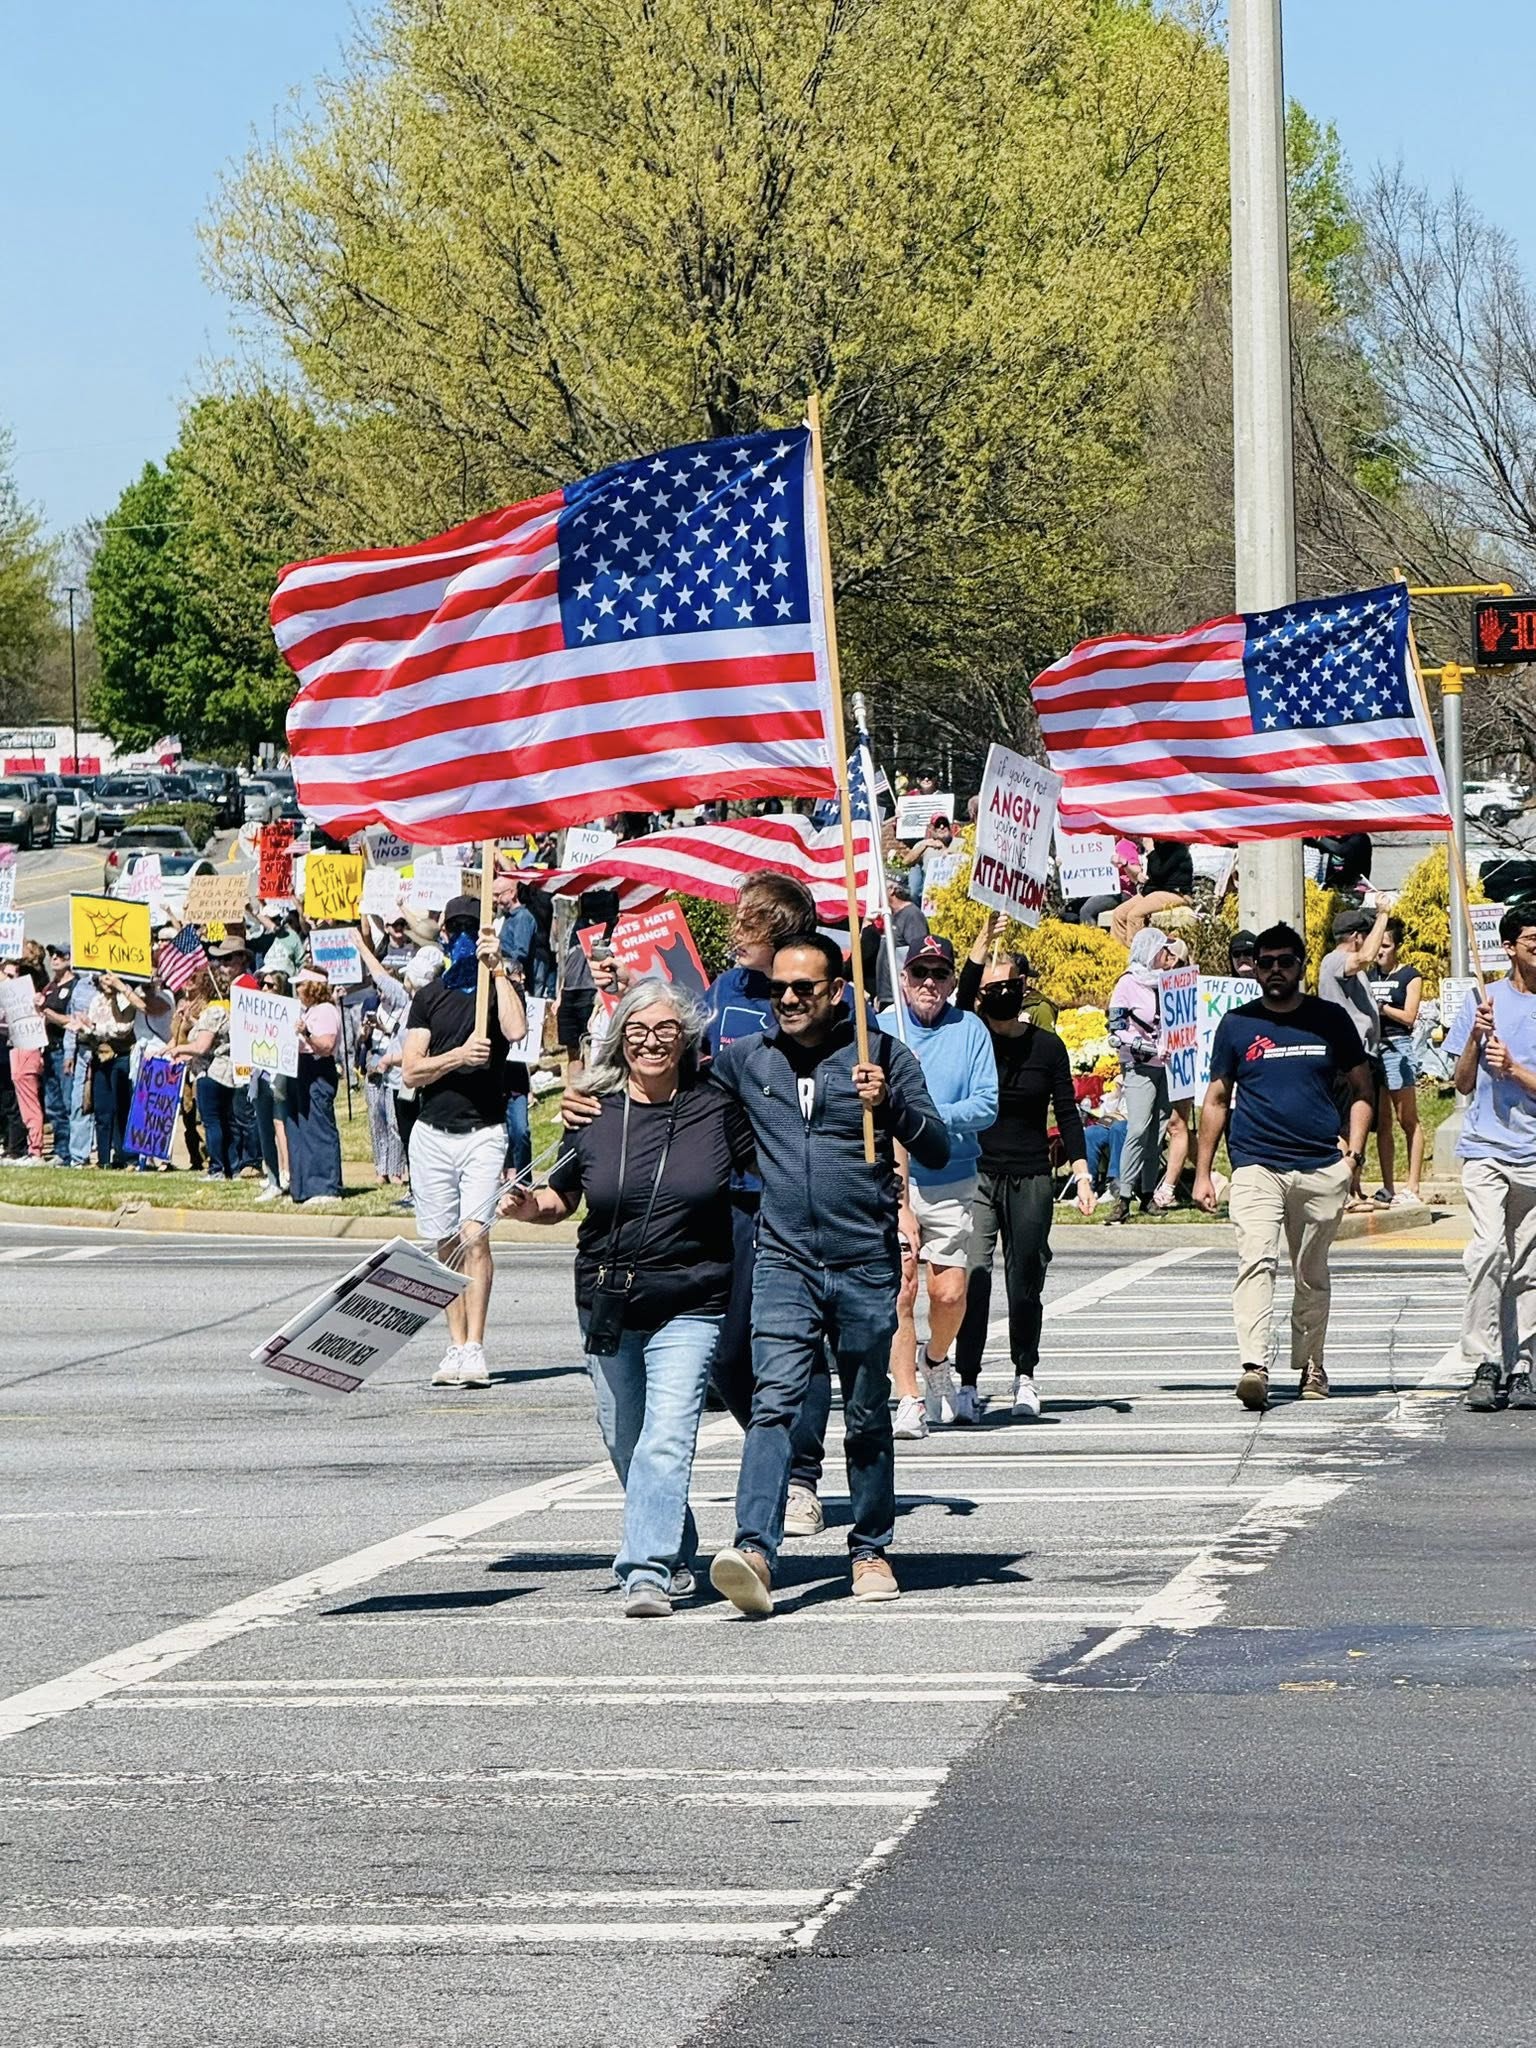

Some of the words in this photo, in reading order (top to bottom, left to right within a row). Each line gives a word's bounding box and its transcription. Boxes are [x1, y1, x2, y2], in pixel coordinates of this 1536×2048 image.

[989, 785, 1041, 831] ANGRY
[379, 834, 398, 846] NO
[582, 832, 600, 844] NO
[571, 851, 595, 864] KIN
[996, 836, 1027, 870] PAYING
[973, 854, 1047, 913] ATTENTION
[643, 909, 677, 928] HATE
[1474, 921, 1497, 932] ORDAN
[621, 926, 670, 949] ORANGE
[84, 942, 99, 956] NO
[109, 943, 145, 964] KINGS
[1162, 976, 1173, 992] WE
[1174, 972, 1191, 989] NEED
[1202, 979, 1229, 994] THE
[1234, 981, 1261, 997] ONL
[237, 993, 289, 1025] AMERICA
[1164, 987, 1198, 1028] SAVE
[264, 1021, 279, 1038] NO
[1172, 1047, 1196, 1089] ACT
[335, 1293, 389, 1321] RANKIN
[372, 1306, 429, 1336] MIRACLE
[306, 1332, 361, 1360] JORDAN
[345, 1344, 379, 1366] JEN
